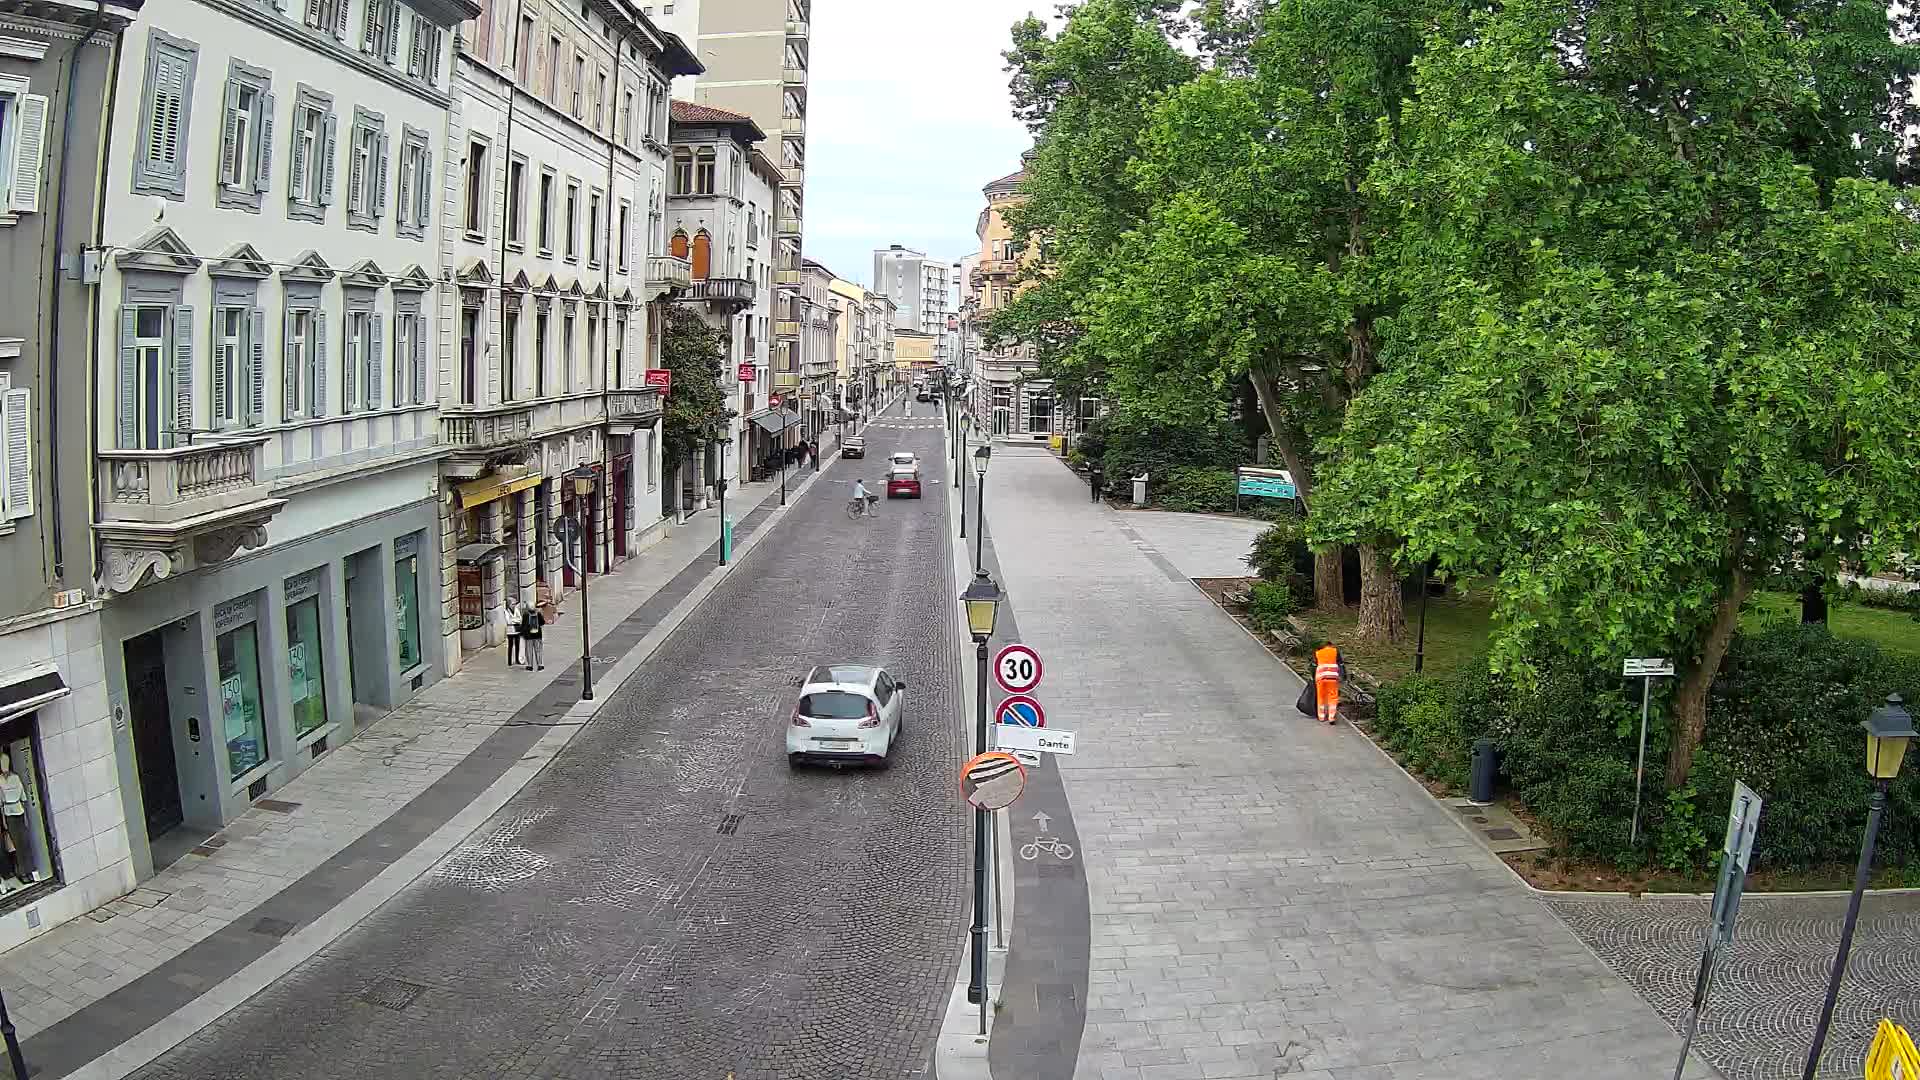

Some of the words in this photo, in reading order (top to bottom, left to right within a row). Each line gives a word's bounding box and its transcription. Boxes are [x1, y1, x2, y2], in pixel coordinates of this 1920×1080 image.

[1005, 658, 1033, 680] 30
[222, 678, 240, 700] 130
[1038, 738, 1070, 750] Dante
